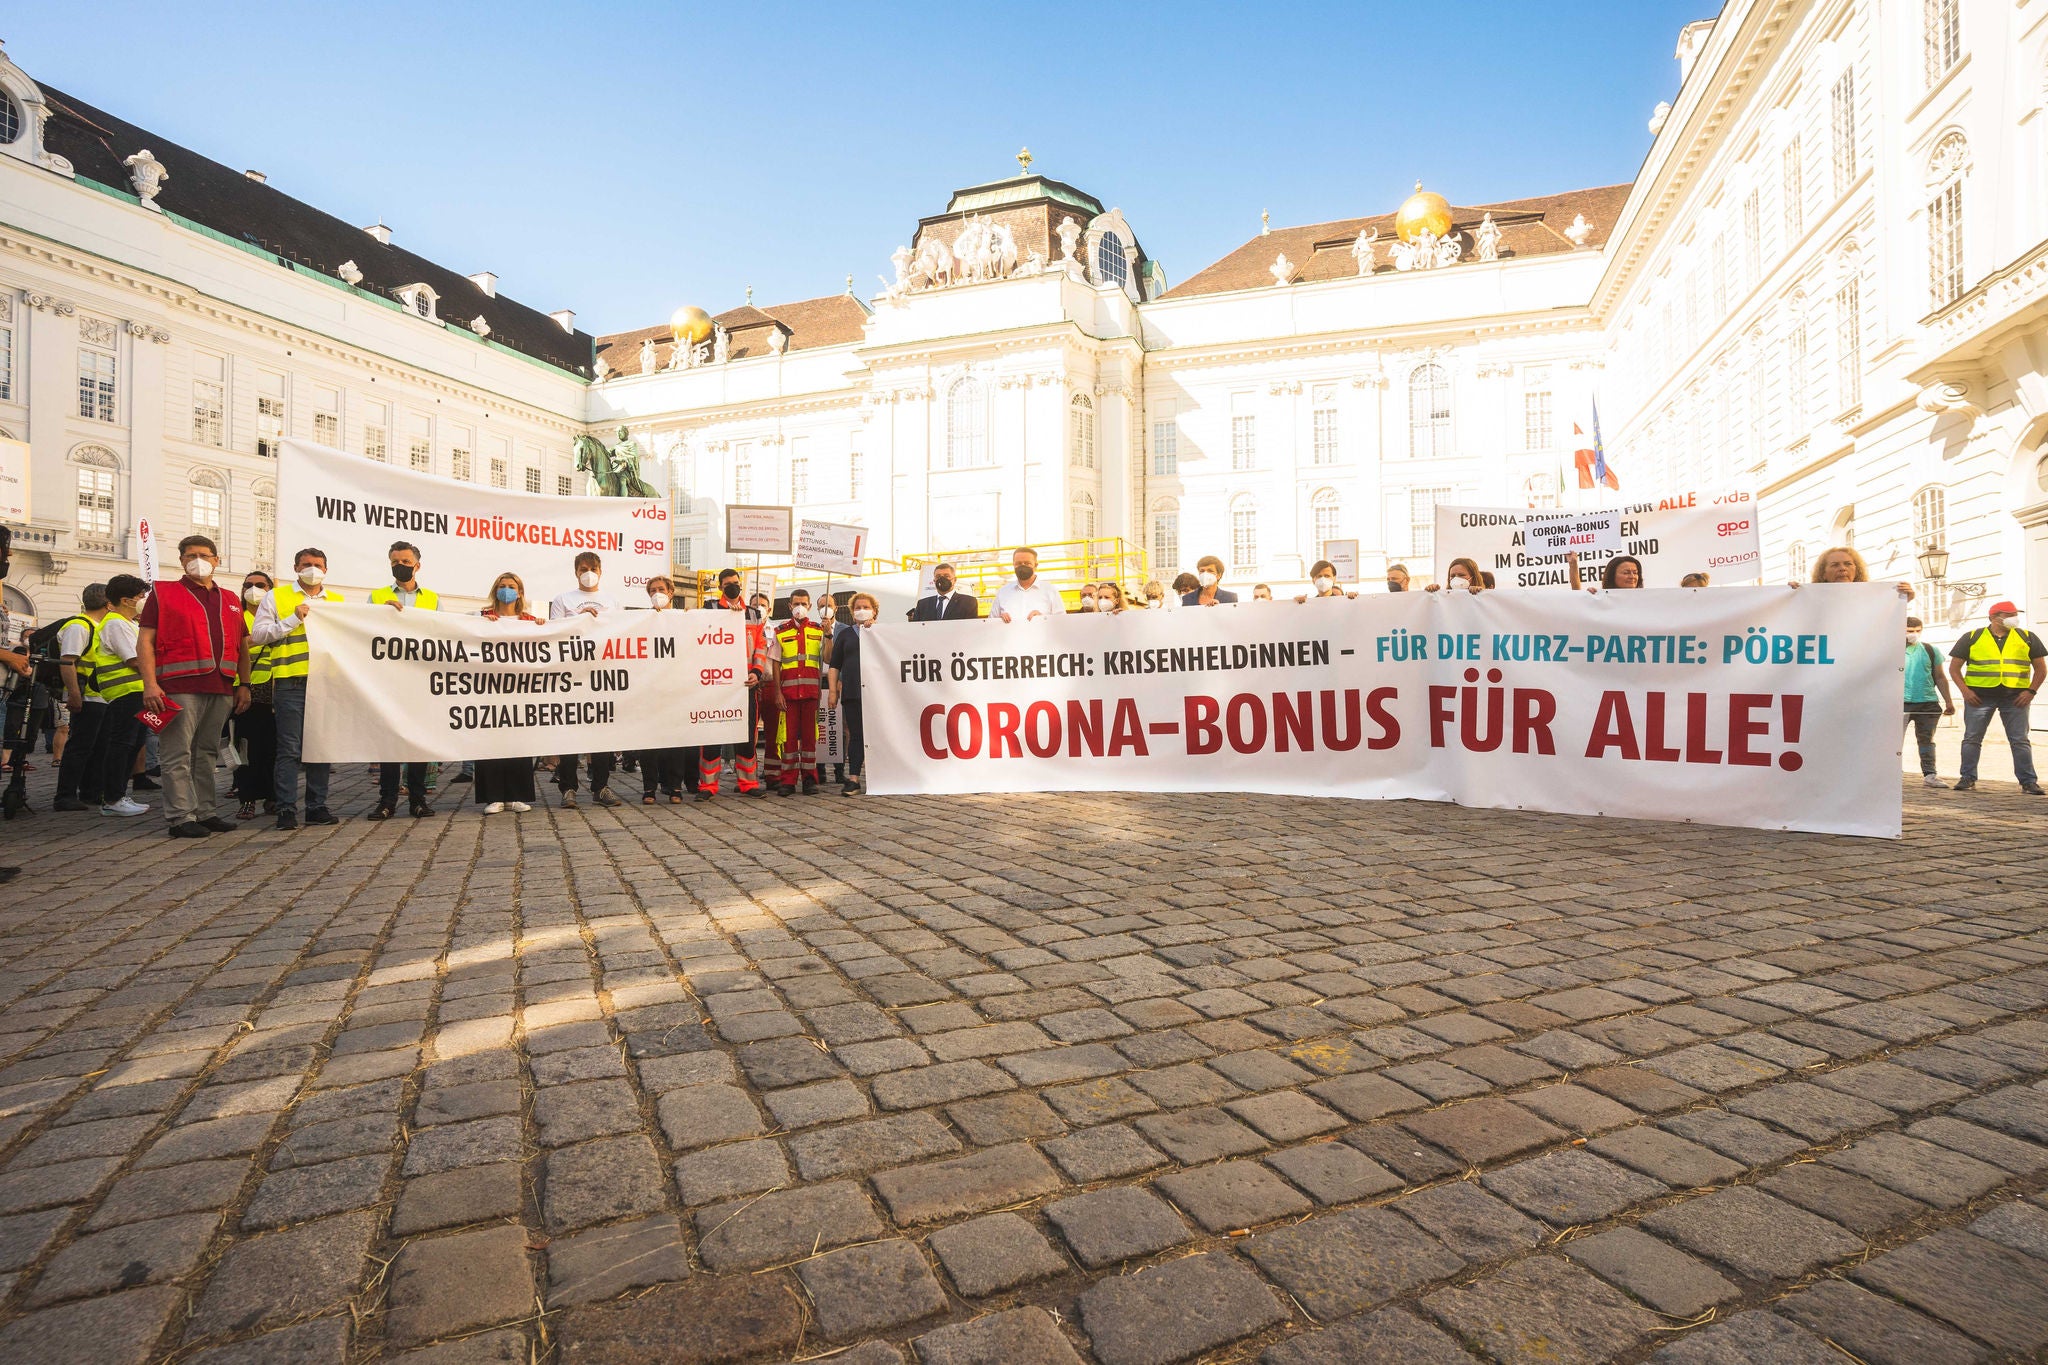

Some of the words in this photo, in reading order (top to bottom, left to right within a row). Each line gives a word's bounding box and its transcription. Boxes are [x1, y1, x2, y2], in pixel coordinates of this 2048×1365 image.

[1658, 491, 1697, 511] ALLE
[1713, 490, 1750, 505] vida
[632, 501, 667, 521] vida
[316, 495, 356, 523] WIR
[364, 503, 448, 535] WERDEN
[455, 515, 623, 552] ZURÜCKGELASSEN!
[1532, 520, 1610, 537] CORONA-BONUS
[1717, 520, 1750, 537] gpa
[634, 539, 664, 555] gpa
[1547, 536, 1566, 547] FÜR
[1569, 534, 1595, 545] ALLE!
[1495, 553, 1511, 569] IM
[1628, 538, 1659, 556] UND
[1708, 551, 1759, 568] younion
[697, 624, 735, 646] vida
[371, 636, 551, 664] CORONA-BONUS
[559, 635, 596, 663] FÜR
[602, 637, 648, 661] ALLE
[654, 637, 675, 659] IM
[900, 653, 942, 683] FÜR
[951, 651, 1094, 682] ÖSTERREICH:
[1104, 639, 1329, 676] KRISENHELDiNNEN
[1376, 628, 1427, 662] FÜR
[1438, 634, 1480, 661] DIE
[1492, 634, 1707, 665] KURZ-PARTIE:
[1723, 626, 1835, 665] PÖBEL
[430, 671, 582, 696] GESUNDHEITS-
[590, 669, 629, 692] UND
[700, 668, 733, 686] gpa
[143, 711, 163, 726] gpa
[449, 701, 614, 730] SOZIALBEREICH!
[690, 708, 743, 724] younion
[919, 687, 1401, 760] CORONA-BONUS
[1428, 667, 1557, 756] FÜR
[1584, 690, 1804, 772] ALLE!
